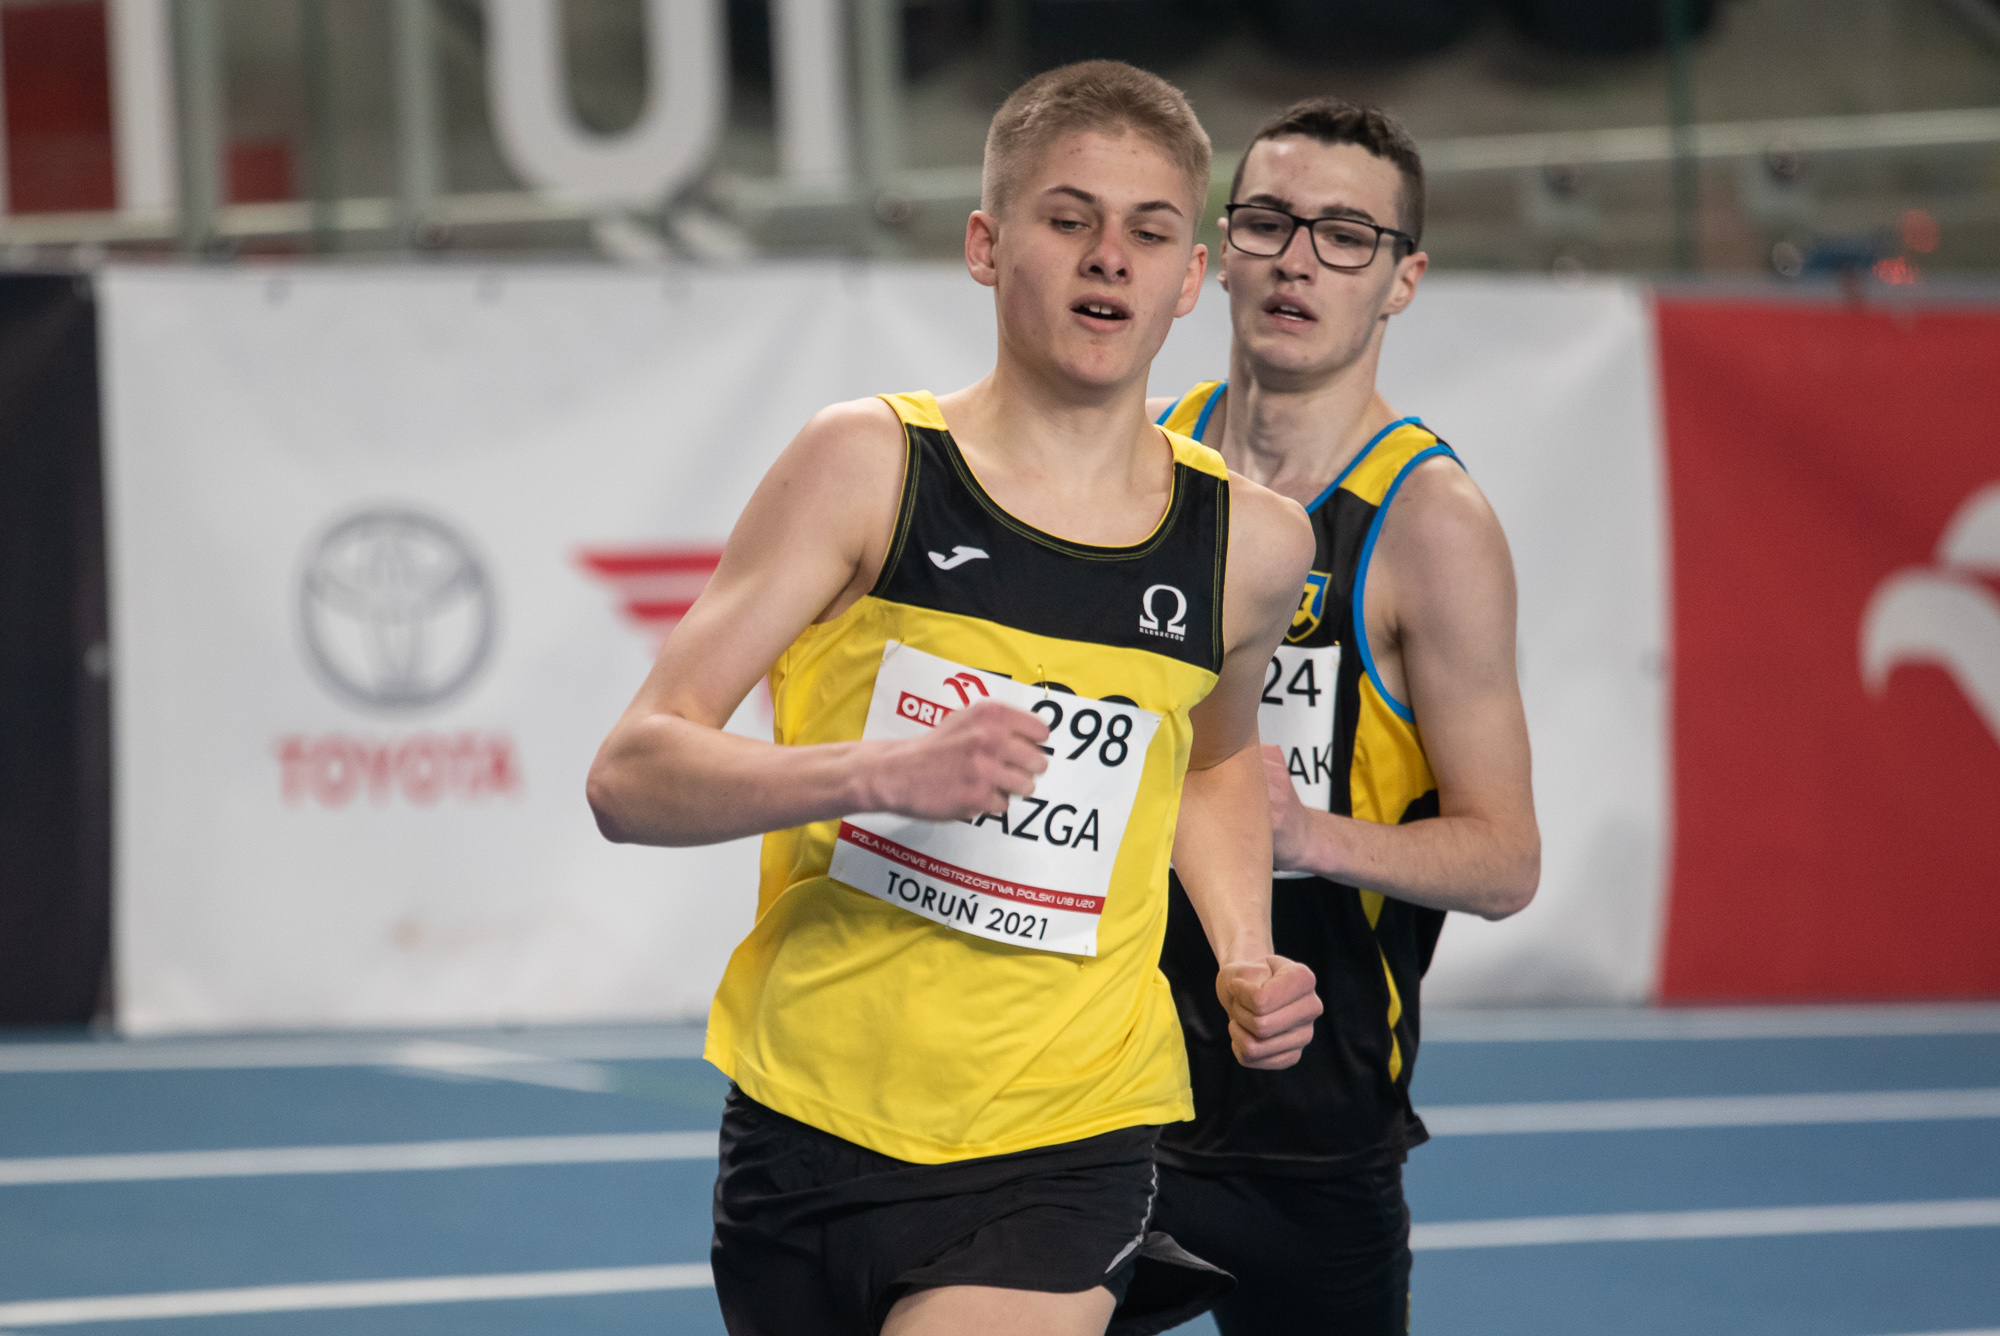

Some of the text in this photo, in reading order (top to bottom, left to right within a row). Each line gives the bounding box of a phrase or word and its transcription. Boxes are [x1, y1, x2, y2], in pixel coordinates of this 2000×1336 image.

[276, 734, 522, 808] TOYOTA
[851, 830, 1096, 909] PZLA HALOWE MISTRZOSTWA POLSKI U18 U20
[887, 870, 1049, 940] TORUŃ 2021
